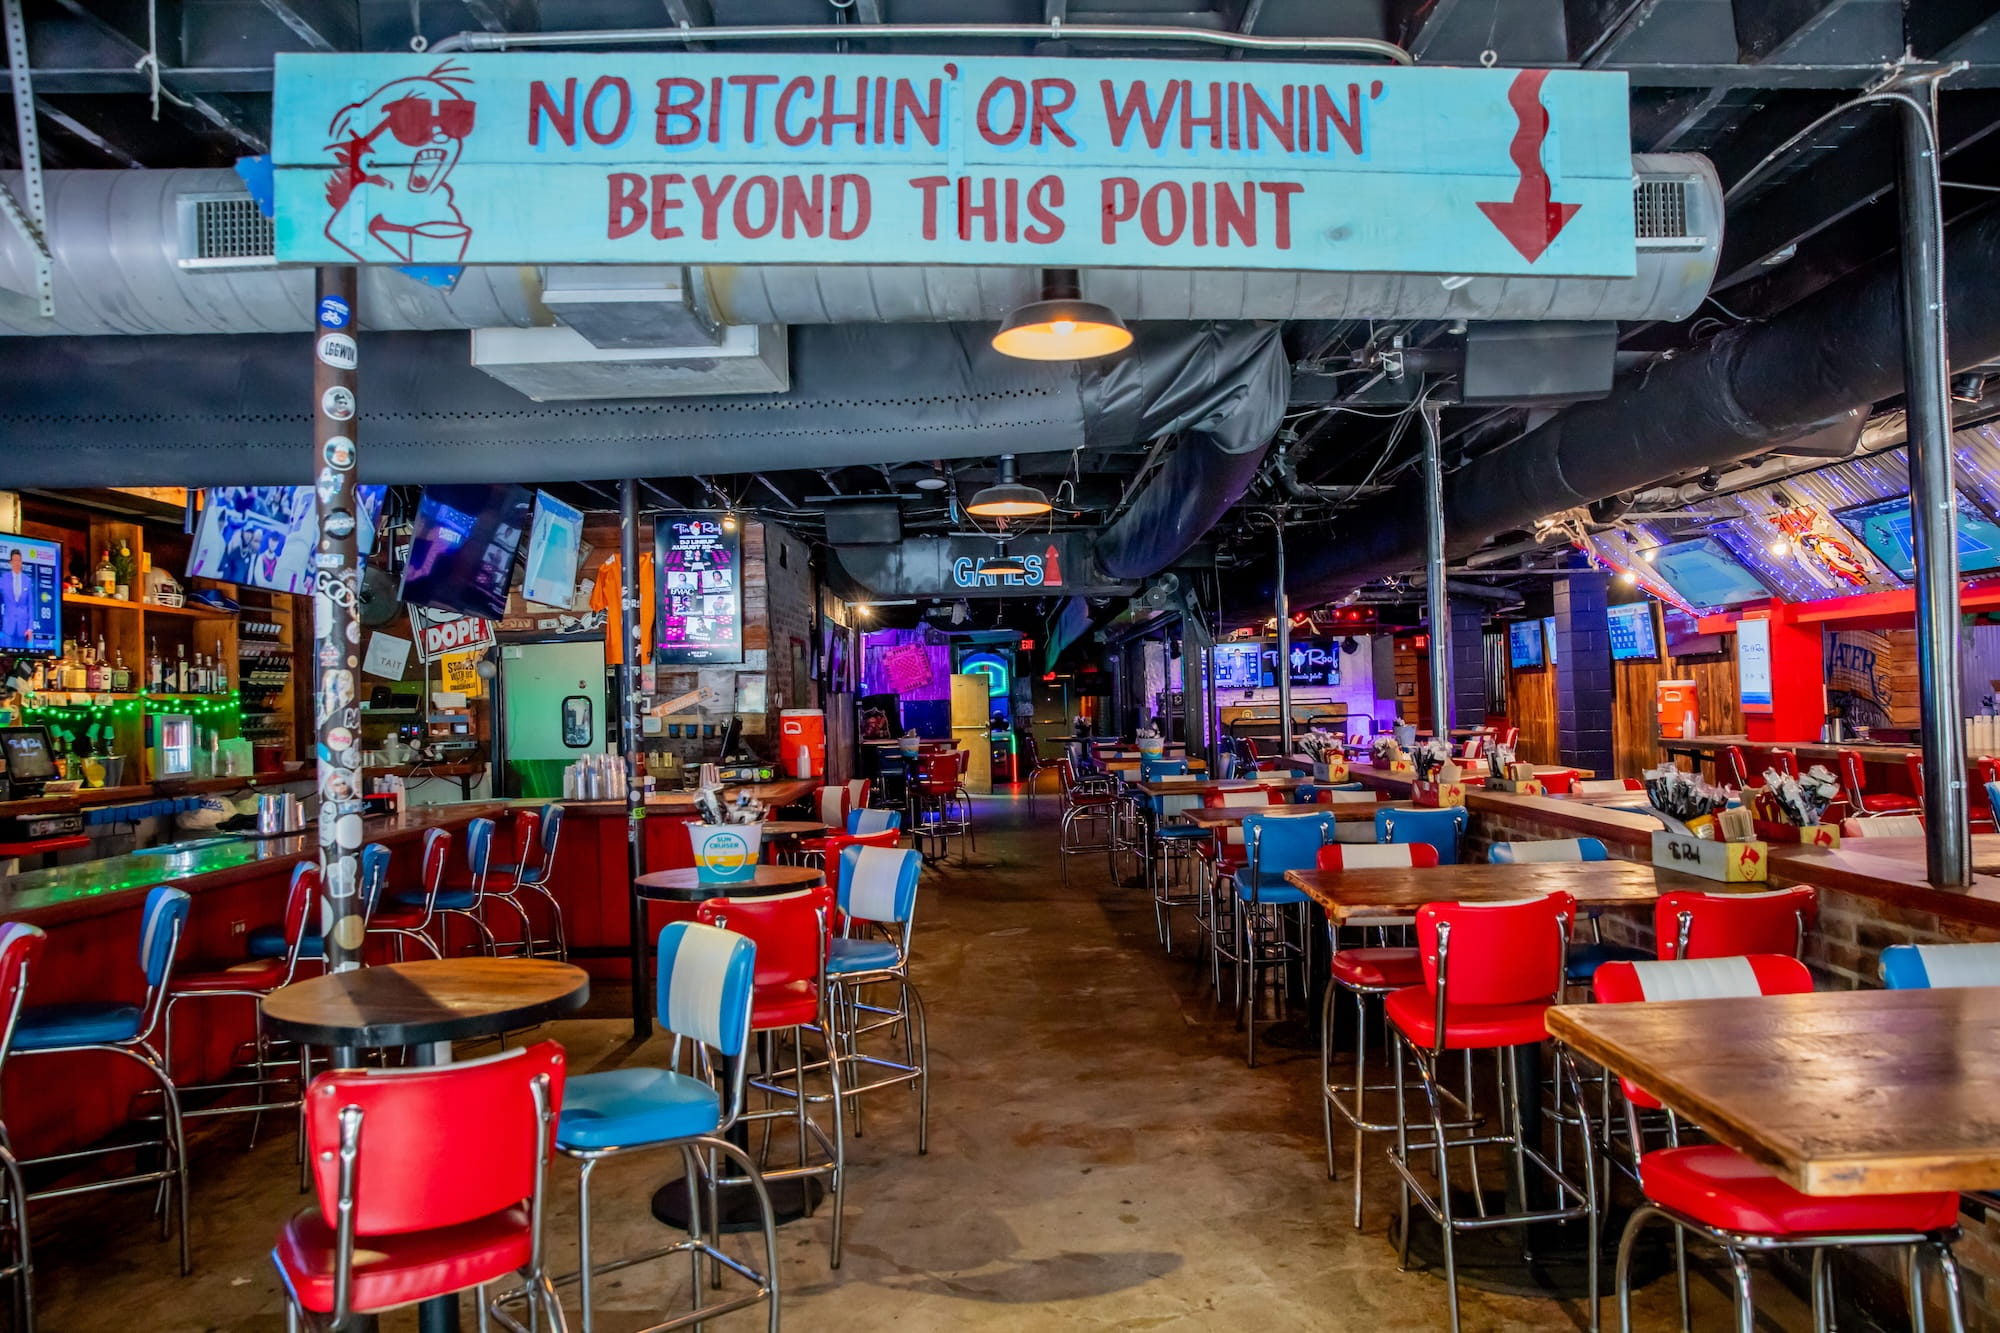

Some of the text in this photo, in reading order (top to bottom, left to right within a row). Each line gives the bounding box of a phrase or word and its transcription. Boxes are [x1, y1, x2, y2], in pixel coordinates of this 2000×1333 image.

[528, 62, 1384, 155] NO BITCHIN' OR WHININ'
[607, 172, 1305, 250] BEYOND THIS POINT
[429, 617, 480, 652] DOPE
[1021, 640, 1033, 649] EXIT
[382, 657, 402, 670] TAIT
[1306, 648, 1338, 669] Roof
